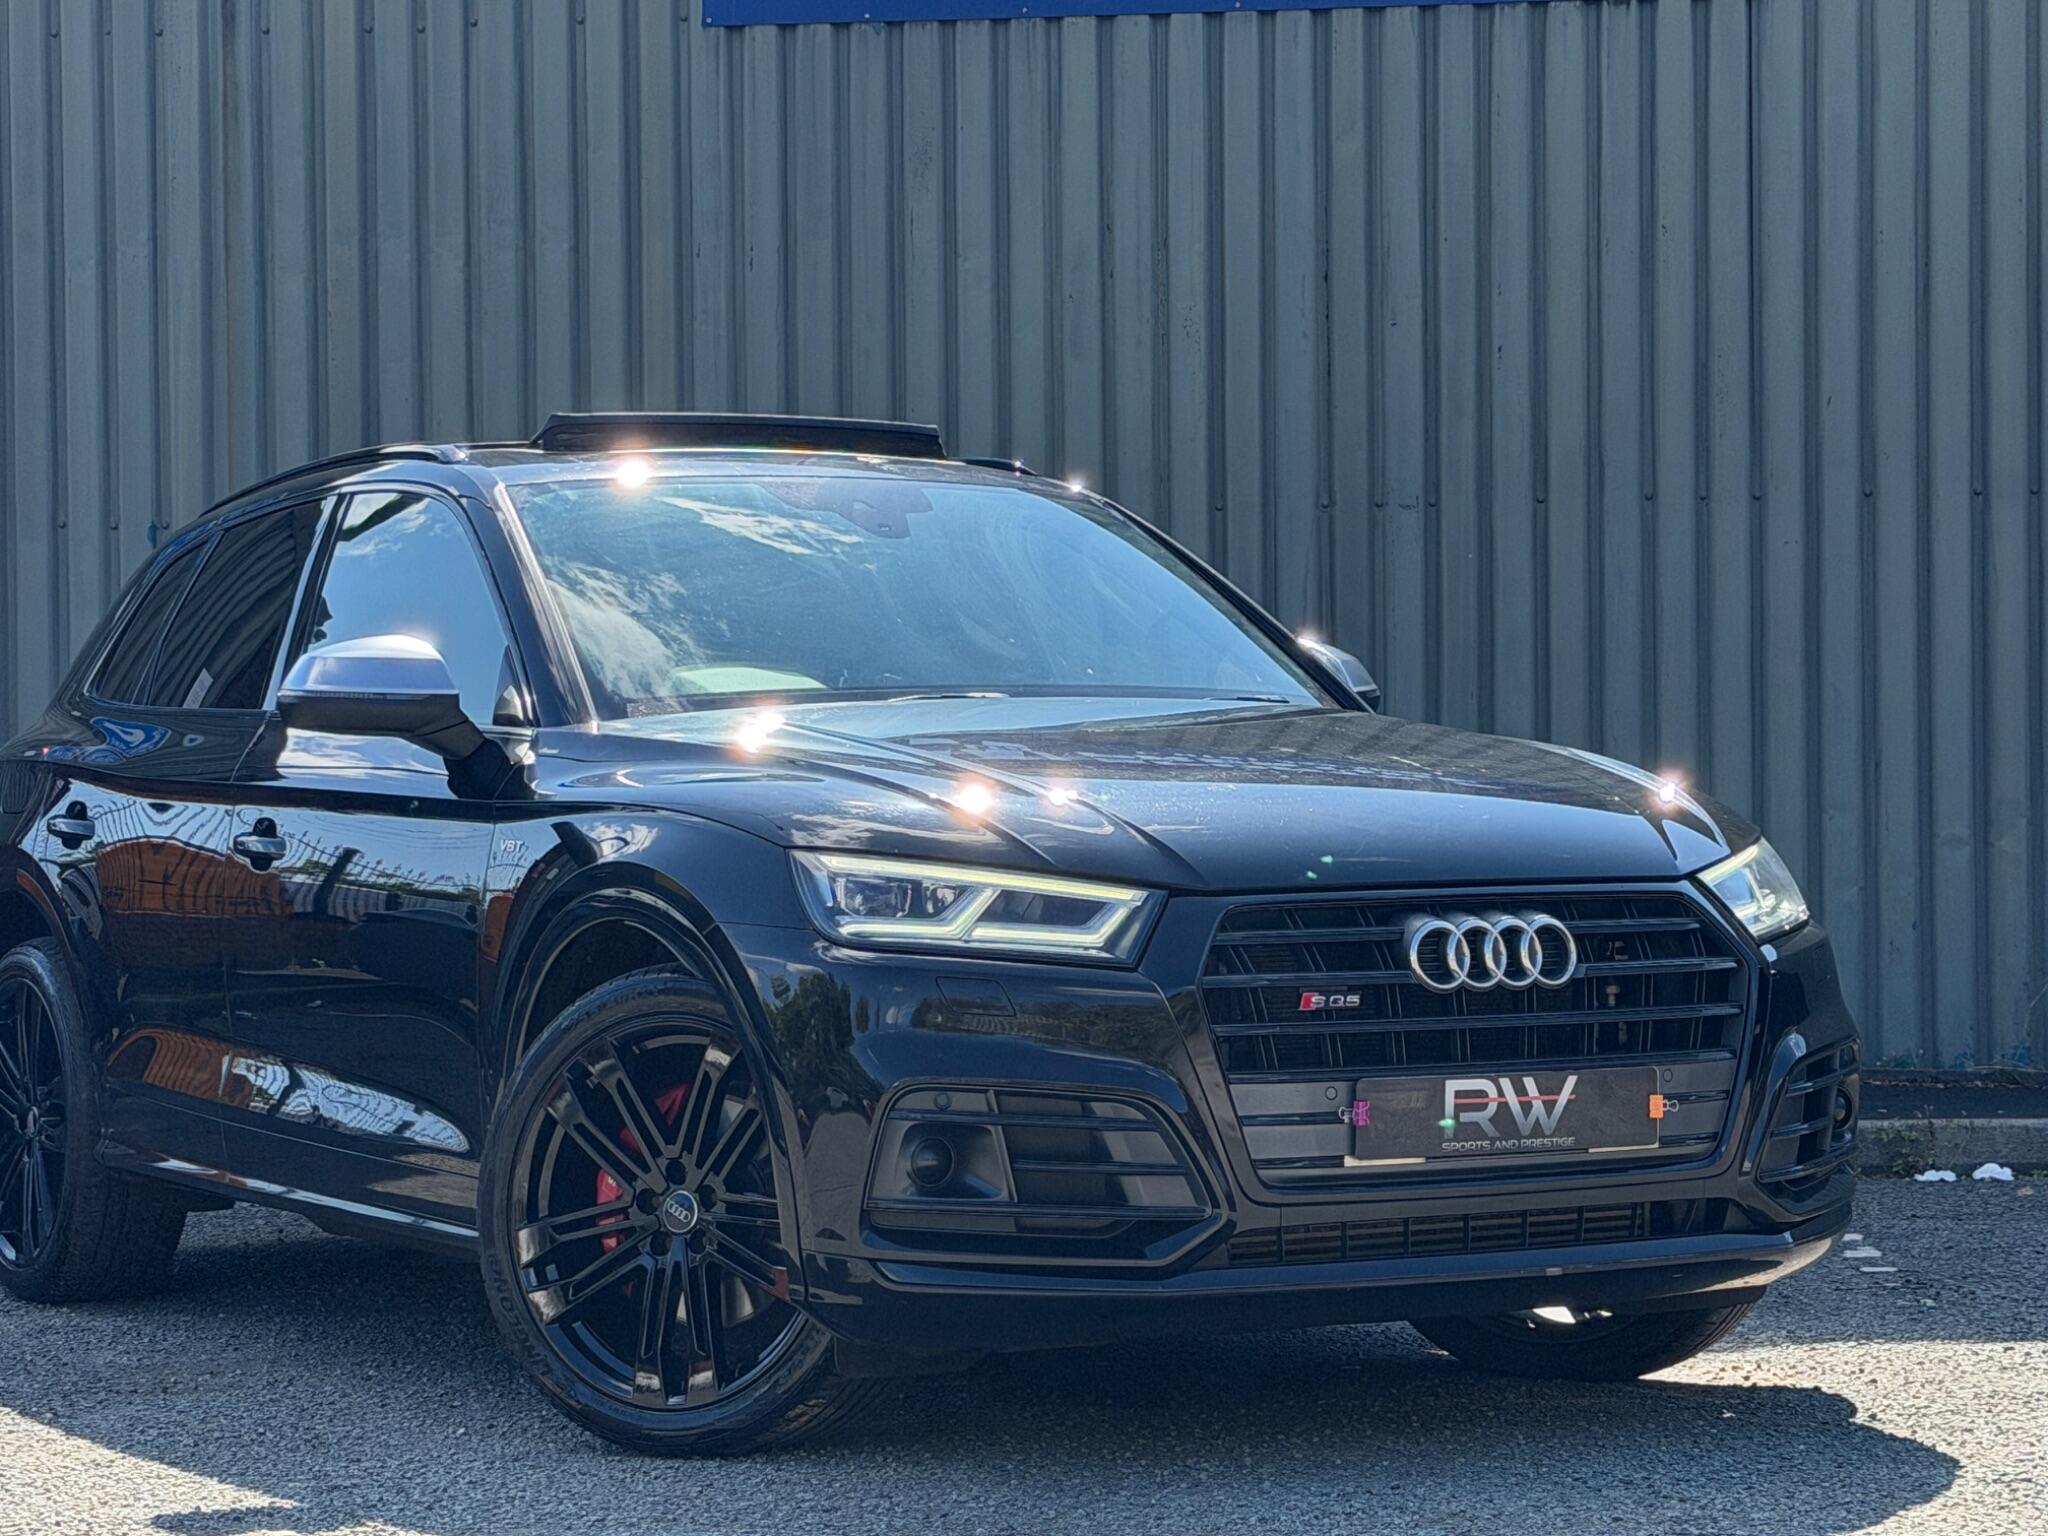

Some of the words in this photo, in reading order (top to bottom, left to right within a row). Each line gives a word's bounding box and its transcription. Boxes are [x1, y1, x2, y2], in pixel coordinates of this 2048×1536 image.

[1303, 993, 1361, 1009] SQ5
[1444, 1075, 1579, 1139] RW
[1441, 1140, 1491, 1152] SPORTS
[1493, 1139, 1519, 1150] AND
[1520, 1136, 1577, 1149] PRESTIGE
